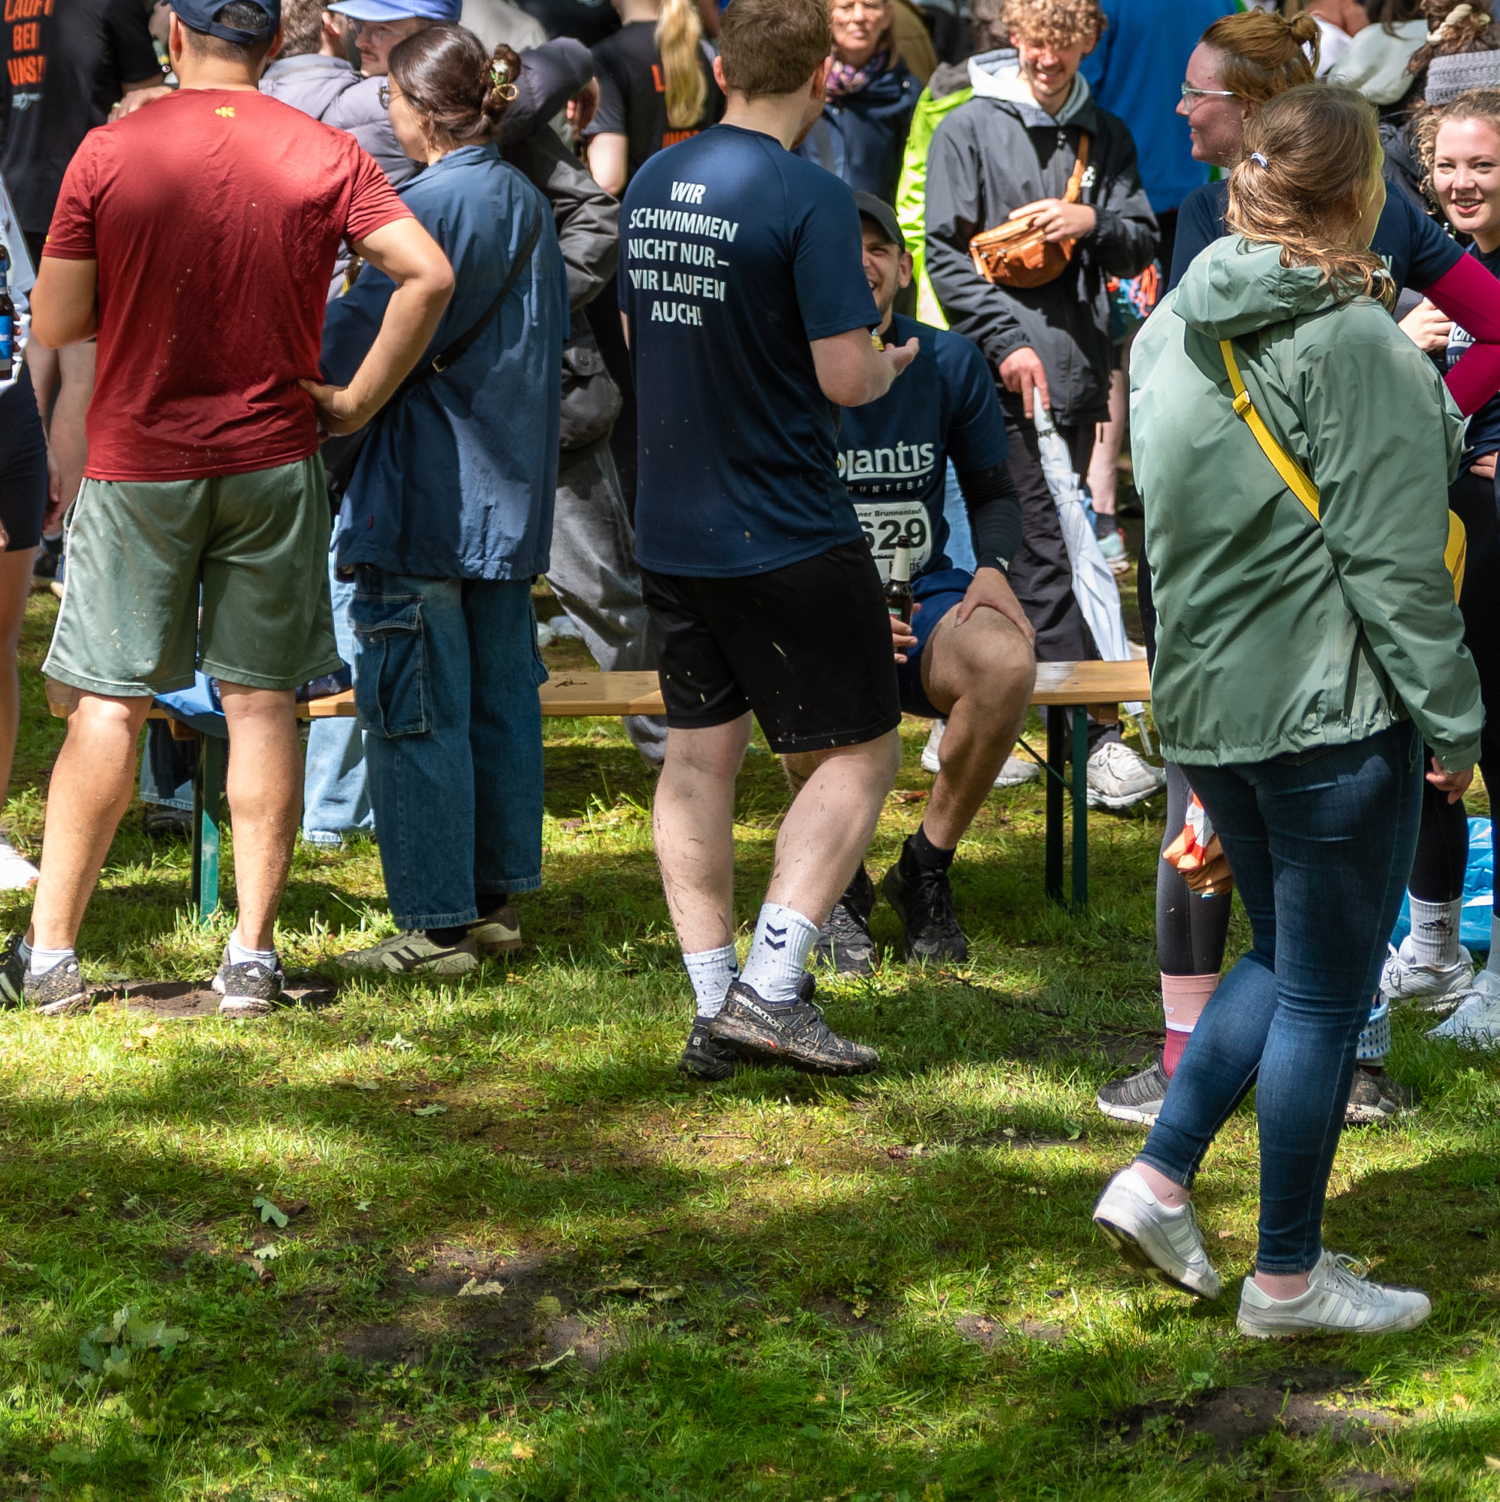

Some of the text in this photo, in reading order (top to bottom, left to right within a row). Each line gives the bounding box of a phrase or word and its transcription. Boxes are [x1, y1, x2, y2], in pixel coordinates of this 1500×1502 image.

[13, 22, 39, 51] BEI
[7, 55, 46, 86] UNS!
[670, 181, 706, 205] WIR
[628, 208, 739, 242] SCHWIMMEN
[628, 239, 678, 262] NICHT
[629, 269, 726, 302] WIR LAUFEN
[651, 301, 704, 326] AUCH!
[874, 508, 921, 517] Brunnenlauf
[735, 994, 783, 1032] salomon
